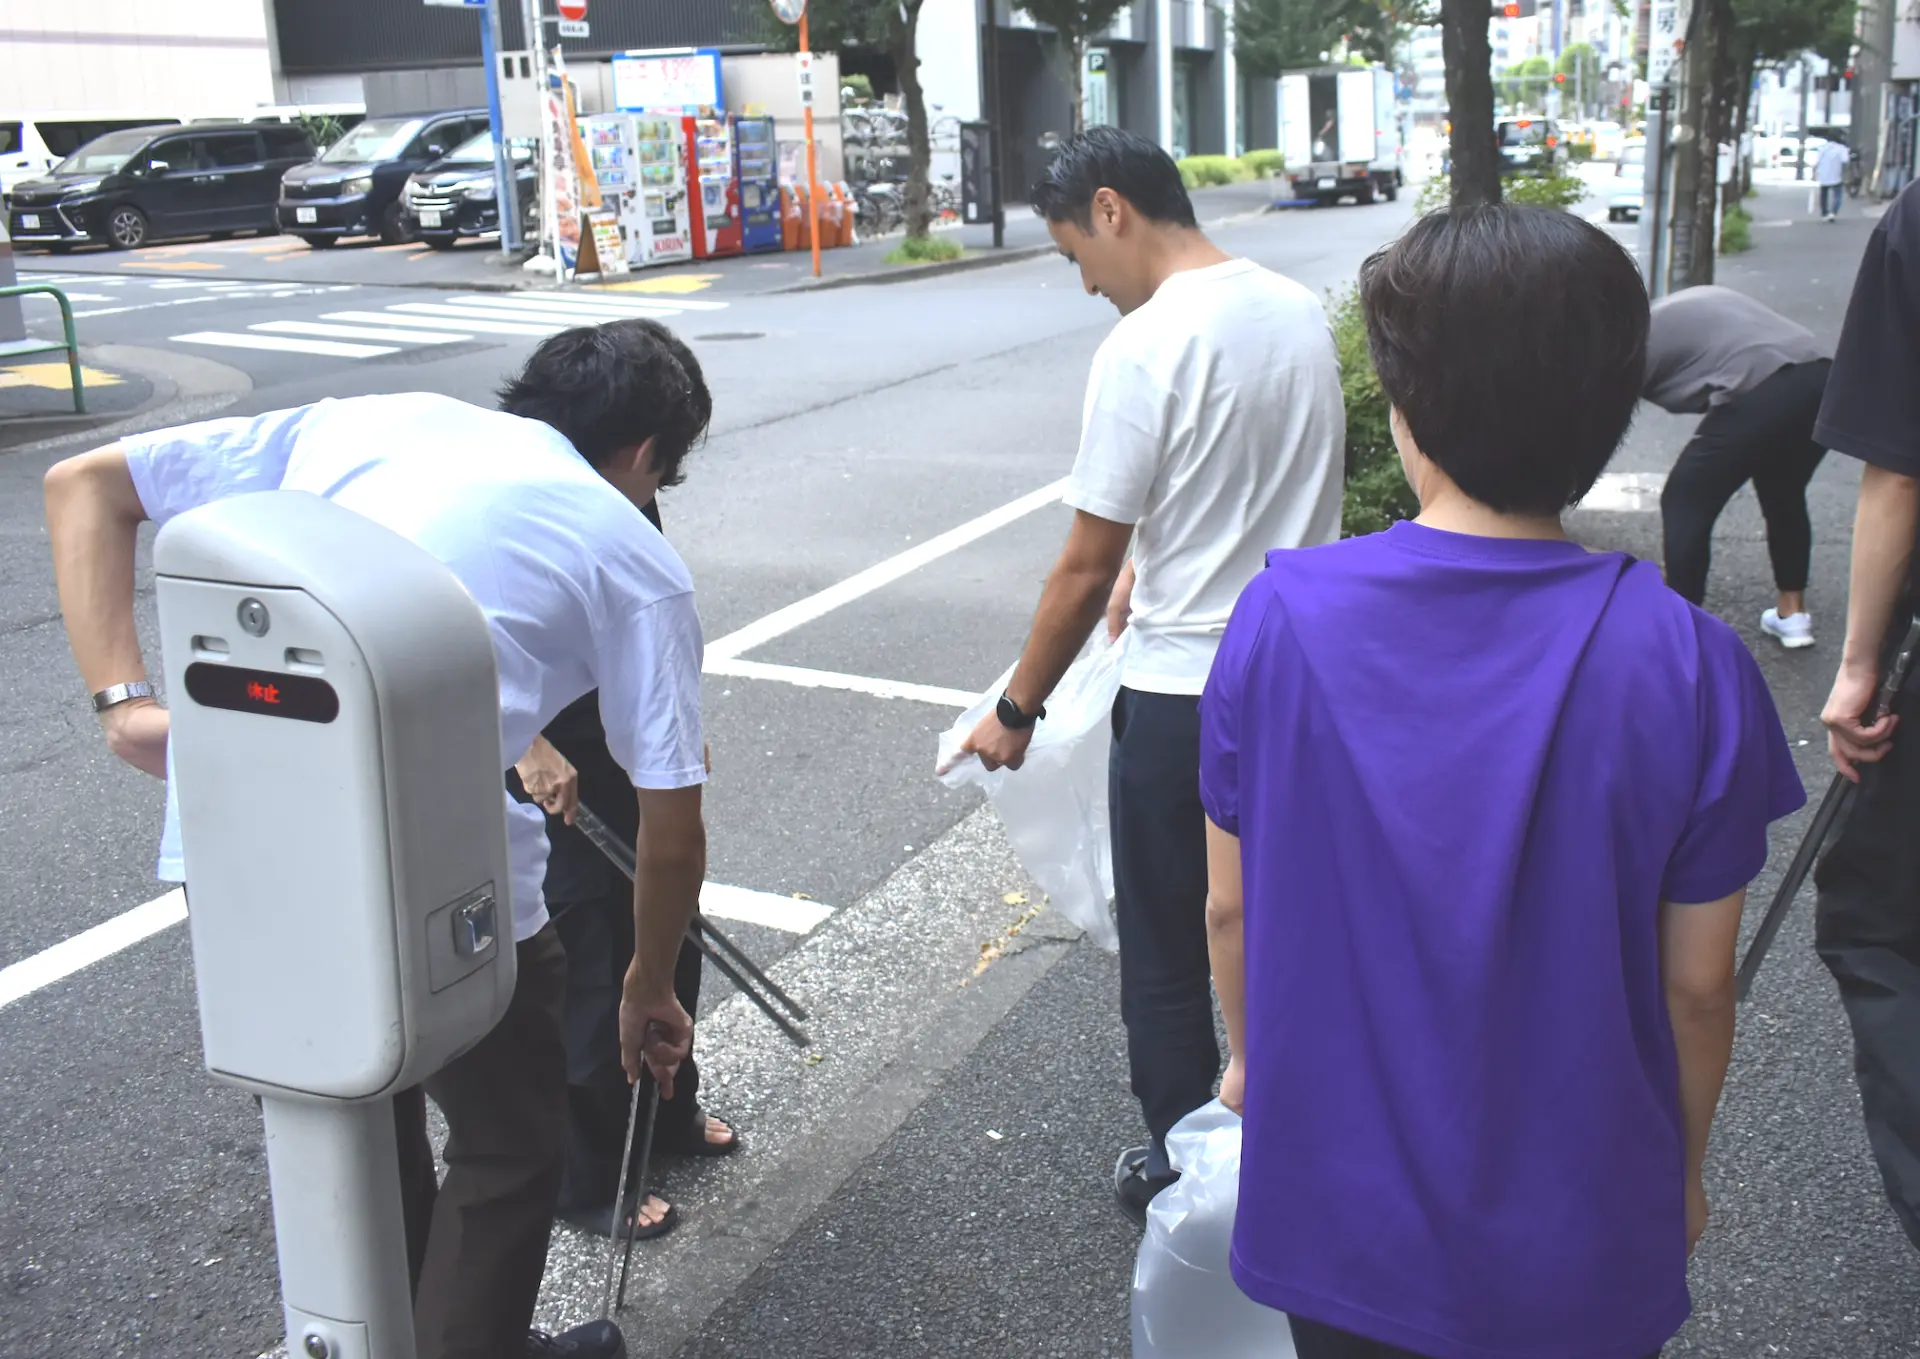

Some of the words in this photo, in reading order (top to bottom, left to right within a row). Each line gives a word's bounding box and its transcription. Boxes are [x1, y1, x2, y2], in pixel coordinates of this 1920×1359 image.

[1656, 0, 1677, 33] 房
[1091, 55, 1104, 71] P
[654, 237, 684, 255] KIRIN
[247, 680, 281, 704] 休止
